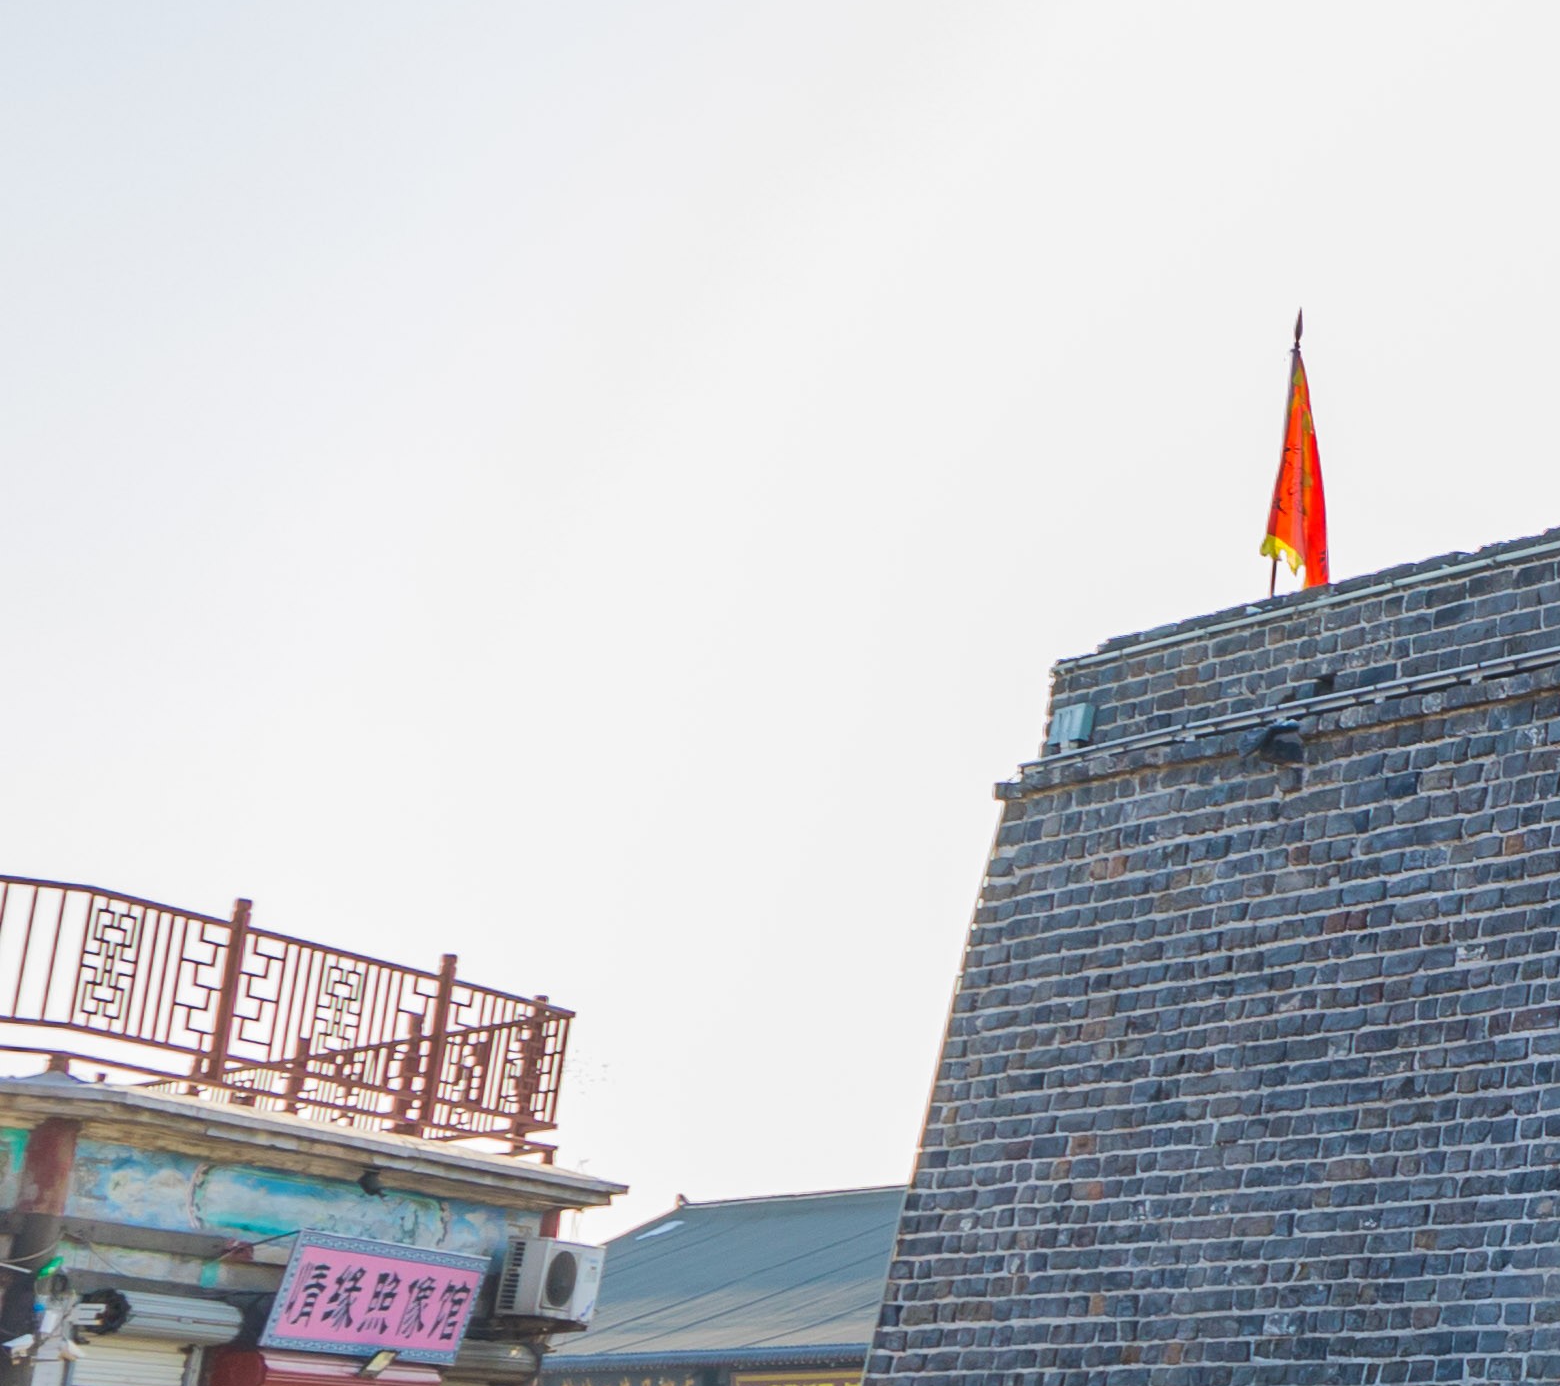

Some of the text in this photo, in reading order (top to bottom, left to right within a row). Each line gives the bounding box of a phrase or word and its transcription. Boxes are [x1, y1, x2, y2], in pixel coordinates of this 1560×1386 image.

[285, 1261, 472, 1341] 情缘照像馆
